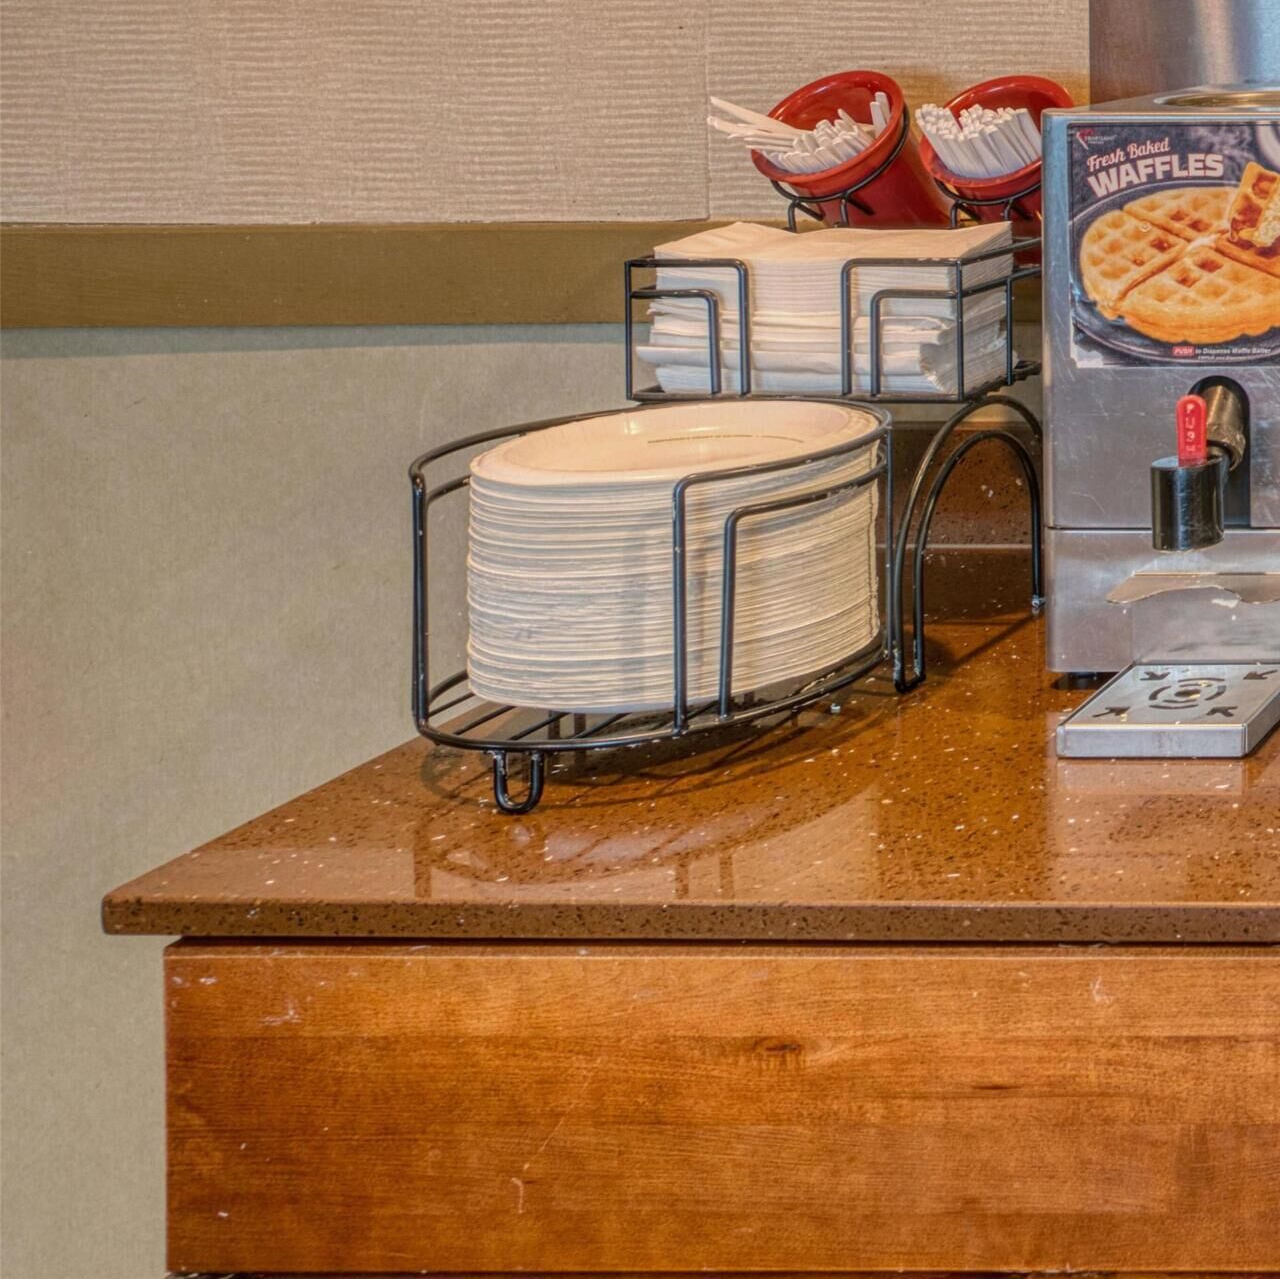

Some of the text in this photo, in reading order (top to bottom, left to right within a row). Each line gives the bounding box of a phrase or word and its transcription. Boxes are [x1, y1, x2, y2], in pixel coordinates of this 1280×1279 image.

[1087, 137, 1170, 172] Fresh Baked
[1087, 152, 1225, 199] WAFFLES
